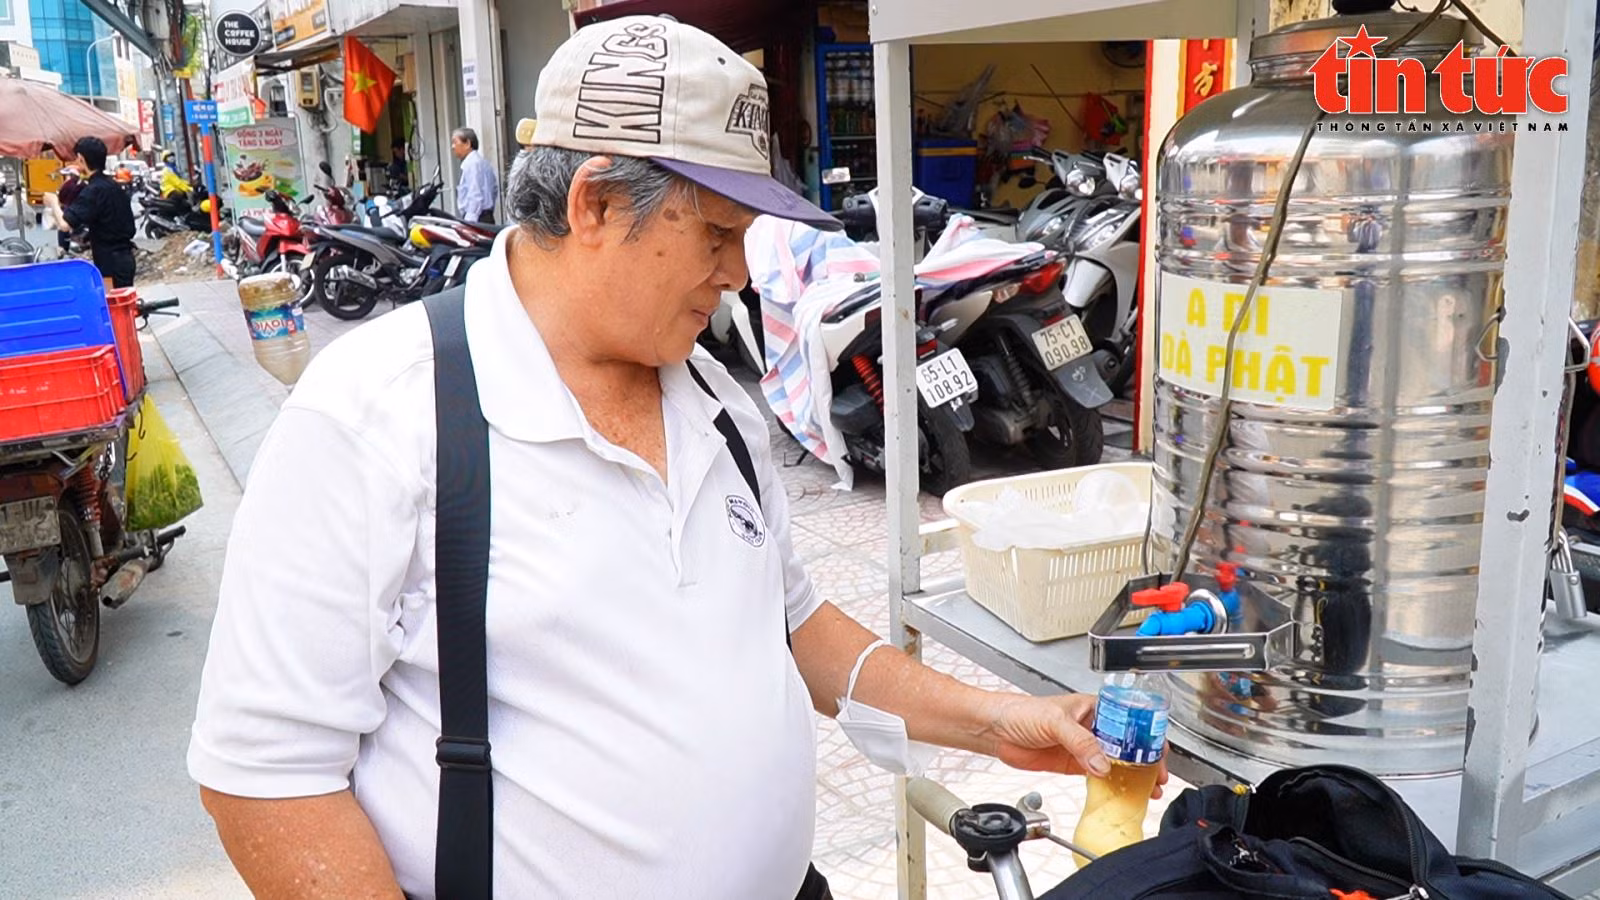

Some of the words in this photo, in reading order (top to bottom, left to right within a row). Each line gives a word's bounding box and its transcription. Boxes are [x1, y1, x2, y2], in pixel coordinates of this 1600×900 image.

[224, 30, 255, 38] COFFEE
[225, 38, 252, 46] HOUSE
[572, 23, 669, 145] KINGS
[1187, 288, 1206, 327] A
[1222, 292, 1270, 336] DI
[1040, 320, 1076, 347] 75-C1
[1044, 335, 1088, 367] 090.98
[926, 370, 973, 402] 108.92
[1206, 345, 1331, 403] PHẬT
